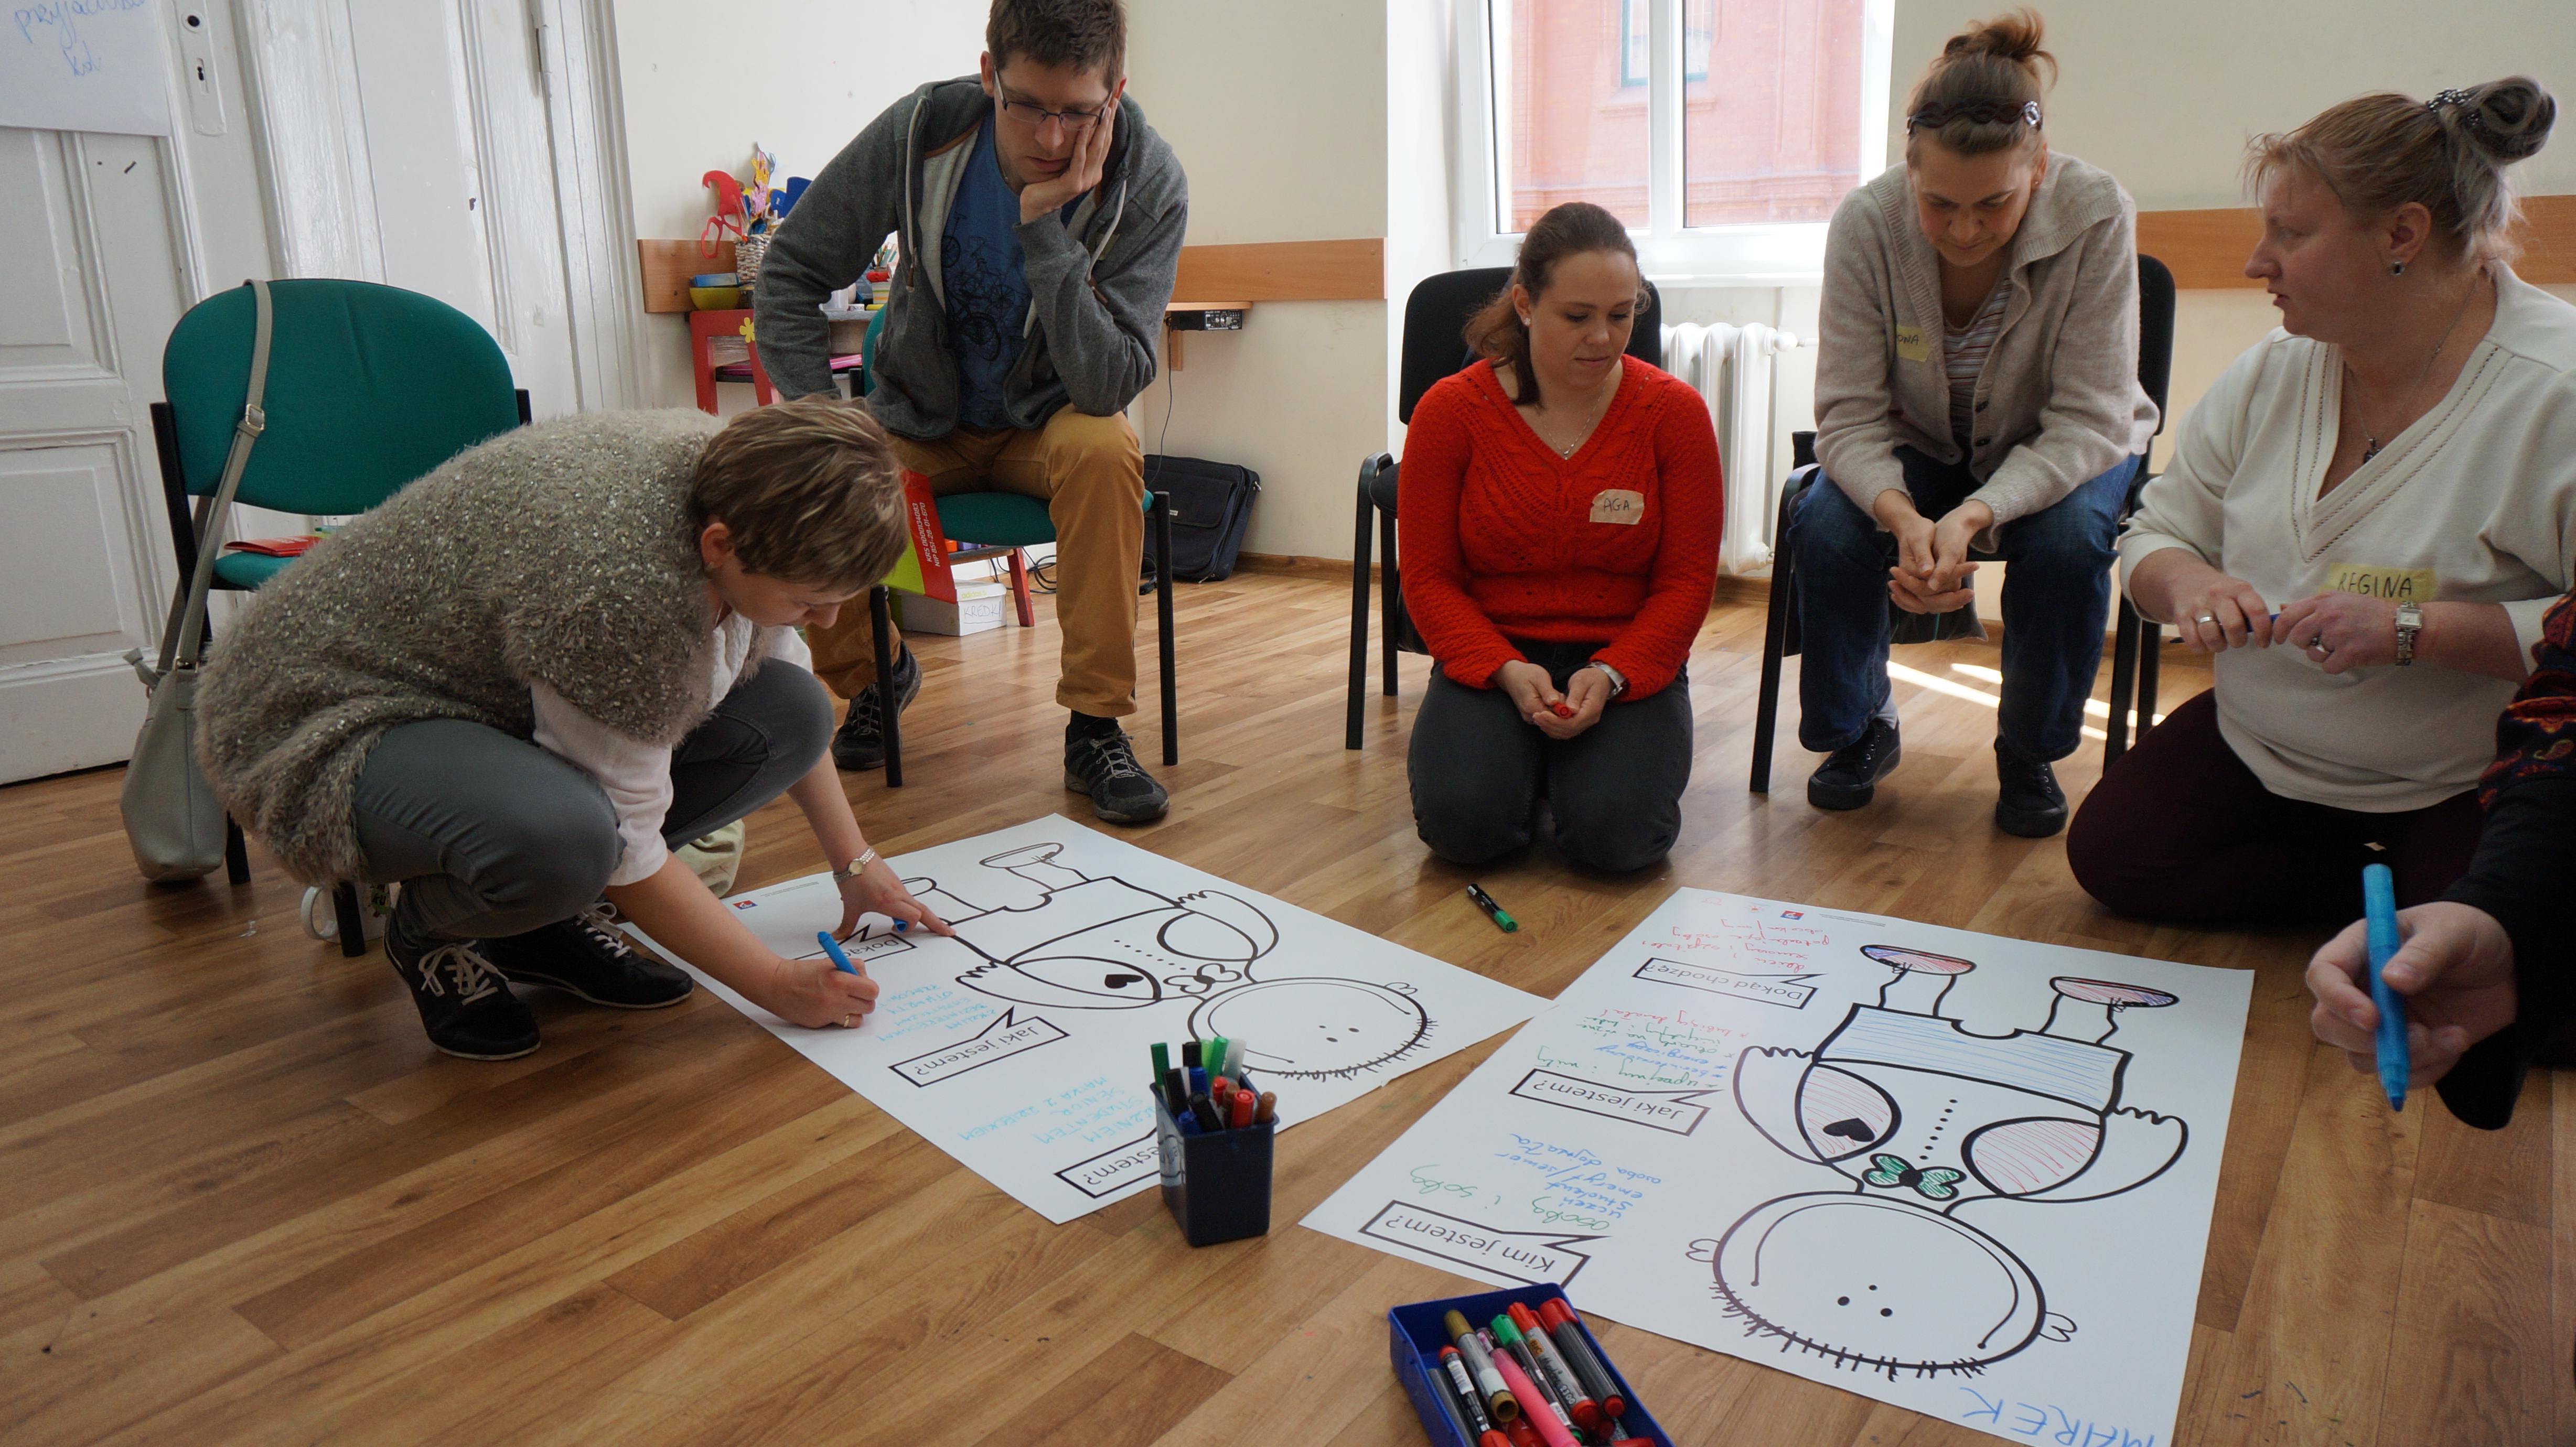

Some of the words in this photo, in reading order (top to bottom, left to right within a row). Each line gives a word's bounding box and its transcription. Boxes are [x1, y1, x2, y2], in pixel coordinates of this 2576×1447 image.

[1604, 498, 1630, 513] AGA
[912, 503, 928, 546] 0000134083
[924, 547, 932, 562] KRS
[2337, 571, 2412, 598] REGINA
[964, 601, 1002, 618] KREDKI
[1643, 965, 1729, 985] chodzę?
[1733, 981, 1804, 1000] Dokąd
[999, 1027, 1038, 1045] Jaki
[914, 1040, 1000, 1076] jestem?
[1533, 1080, 1635, 1109] jestem?
[1634, 1102, 1684, 1120] Jaki
[1083, 1146, 1159, 1185] estem?
[1616, 1167, 1662, 1185] osoba
[1558, 1197, 1623, 1219] uczeń
[1385, 1214, 1500, 1256] jestem?
[1501, 1246, 1555, 1272] Kim
[1529, 1340, 1543, 1356] BIC
[1560, 1384, 1576, 1405] 2300
